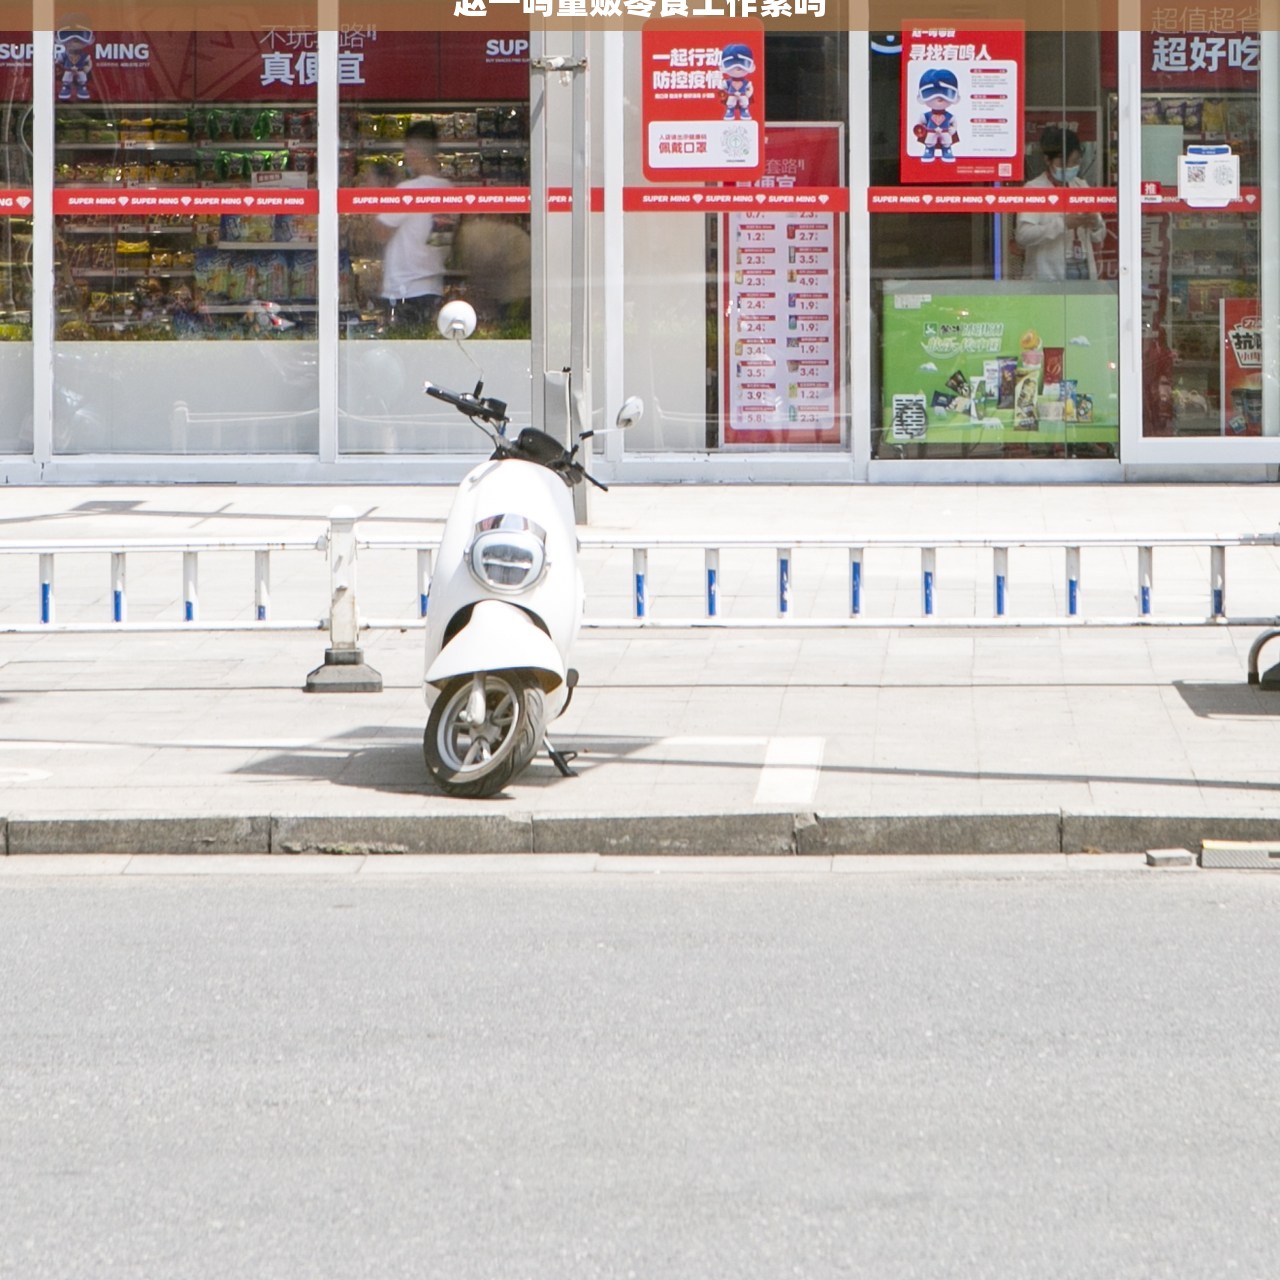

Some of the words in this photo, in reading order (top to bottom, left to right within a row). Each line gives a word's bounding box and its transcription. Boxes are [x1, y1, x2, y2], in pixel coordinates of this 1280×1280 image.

[260, 23, 366, 50] 不玩路
[95, 43, 150, 60] MING
[485, 38, 529, 56] SUP
[652, 48, 722, 67] 一起行动
[1151, 35, 1261, 72] 超好吃
[652, 70, 724, 90] 防控疫情
[1144, 182, 1158, 195] 推
[68, 197, 95, 206] SUPER
[96, 197, 117, 206] MING
[193, 197, 220, 206] SUPER
[221, 197, 242, 206] MING
[256, 197, 283, 206] SUPER
[284, 197, 305, 206] MING
[352, 196, 379, 205] SUPER
[380, 196, 401, 205] MING
[477, 195, 504, 204] SUPER
[505, 195, 526, 204] MING
[642, 195, 669, 204] SUPER
[670, 195, 691, 204] MING
[768, 195, 795, 204] SUPER
[796, 195, 817, 204] MING
[872, 195, 899, 204] SUPER
[900, 195, 921, 204] MING
[997, 195, 1024, 204] SUPER
[1025, 195, 1046, 204] MING
[1069, 196, 1095, 204] SUPER
[1096, 196, 1117, 204] MING
[746, 233, 762, 241] 1.2
[799, 233, 815, 241] 2.7
[746, 255, 762, 264] 2.3
[799, 255, 815, 264] 3.5
[746, 278, 762, 286] 2.3
[799, 277, 815, 286] 4.9
[746, 301, 762, 309] 2.4
[799, 301, 815, 310] 1.9
[746, 324, 762, 332] 2.4
[799, 324, 815, 332] 1.9
[746, 346, 762, 355] 3.4
[799, 345, 815, 353] 1.9
[746, 369, 762, 377] 3.5
[799, 368, 815, 376] 3.4
[746, 391, 762, 400] 3.9
[799, 391, 815, 399] 1.2
